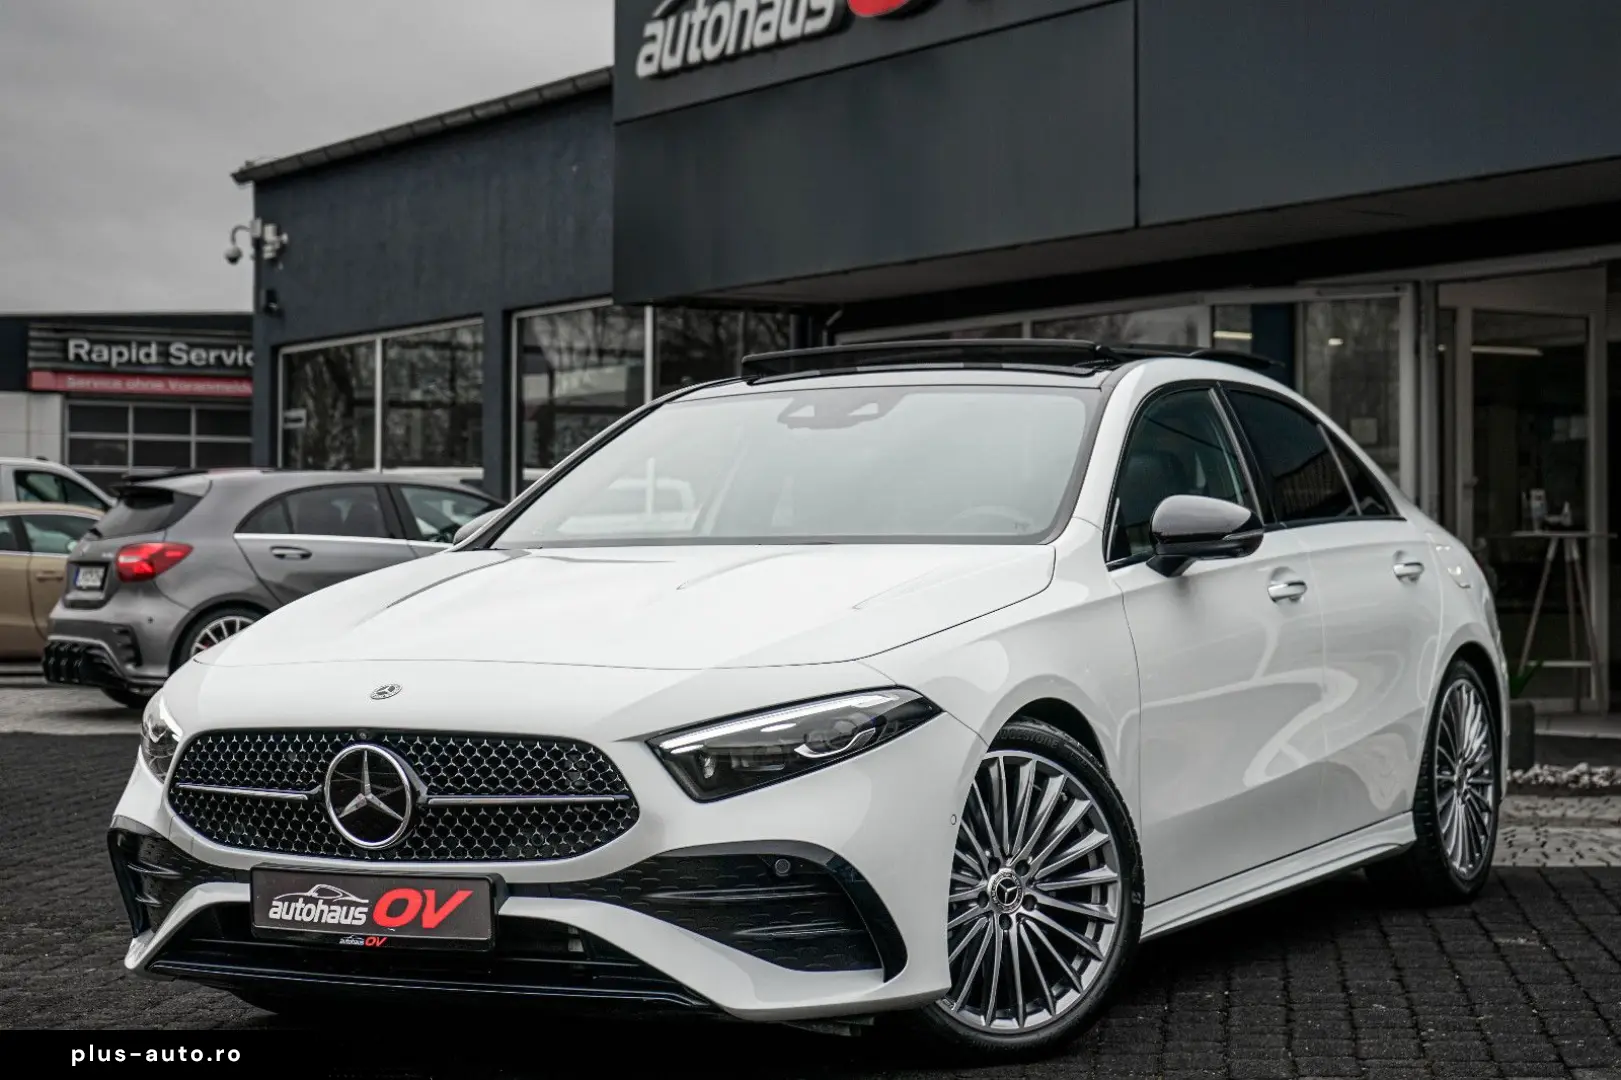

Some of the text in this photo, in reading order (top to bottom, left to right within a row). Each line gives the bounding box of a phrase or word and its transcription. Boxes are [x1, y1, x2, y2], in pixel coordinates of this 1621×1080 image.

[635, 0, 834, 78] autohaus
[67, 338, 157, 369] Rapid
[268, 888, 474, 929] autohaus OV
[365, 936, 387, 947] OV
